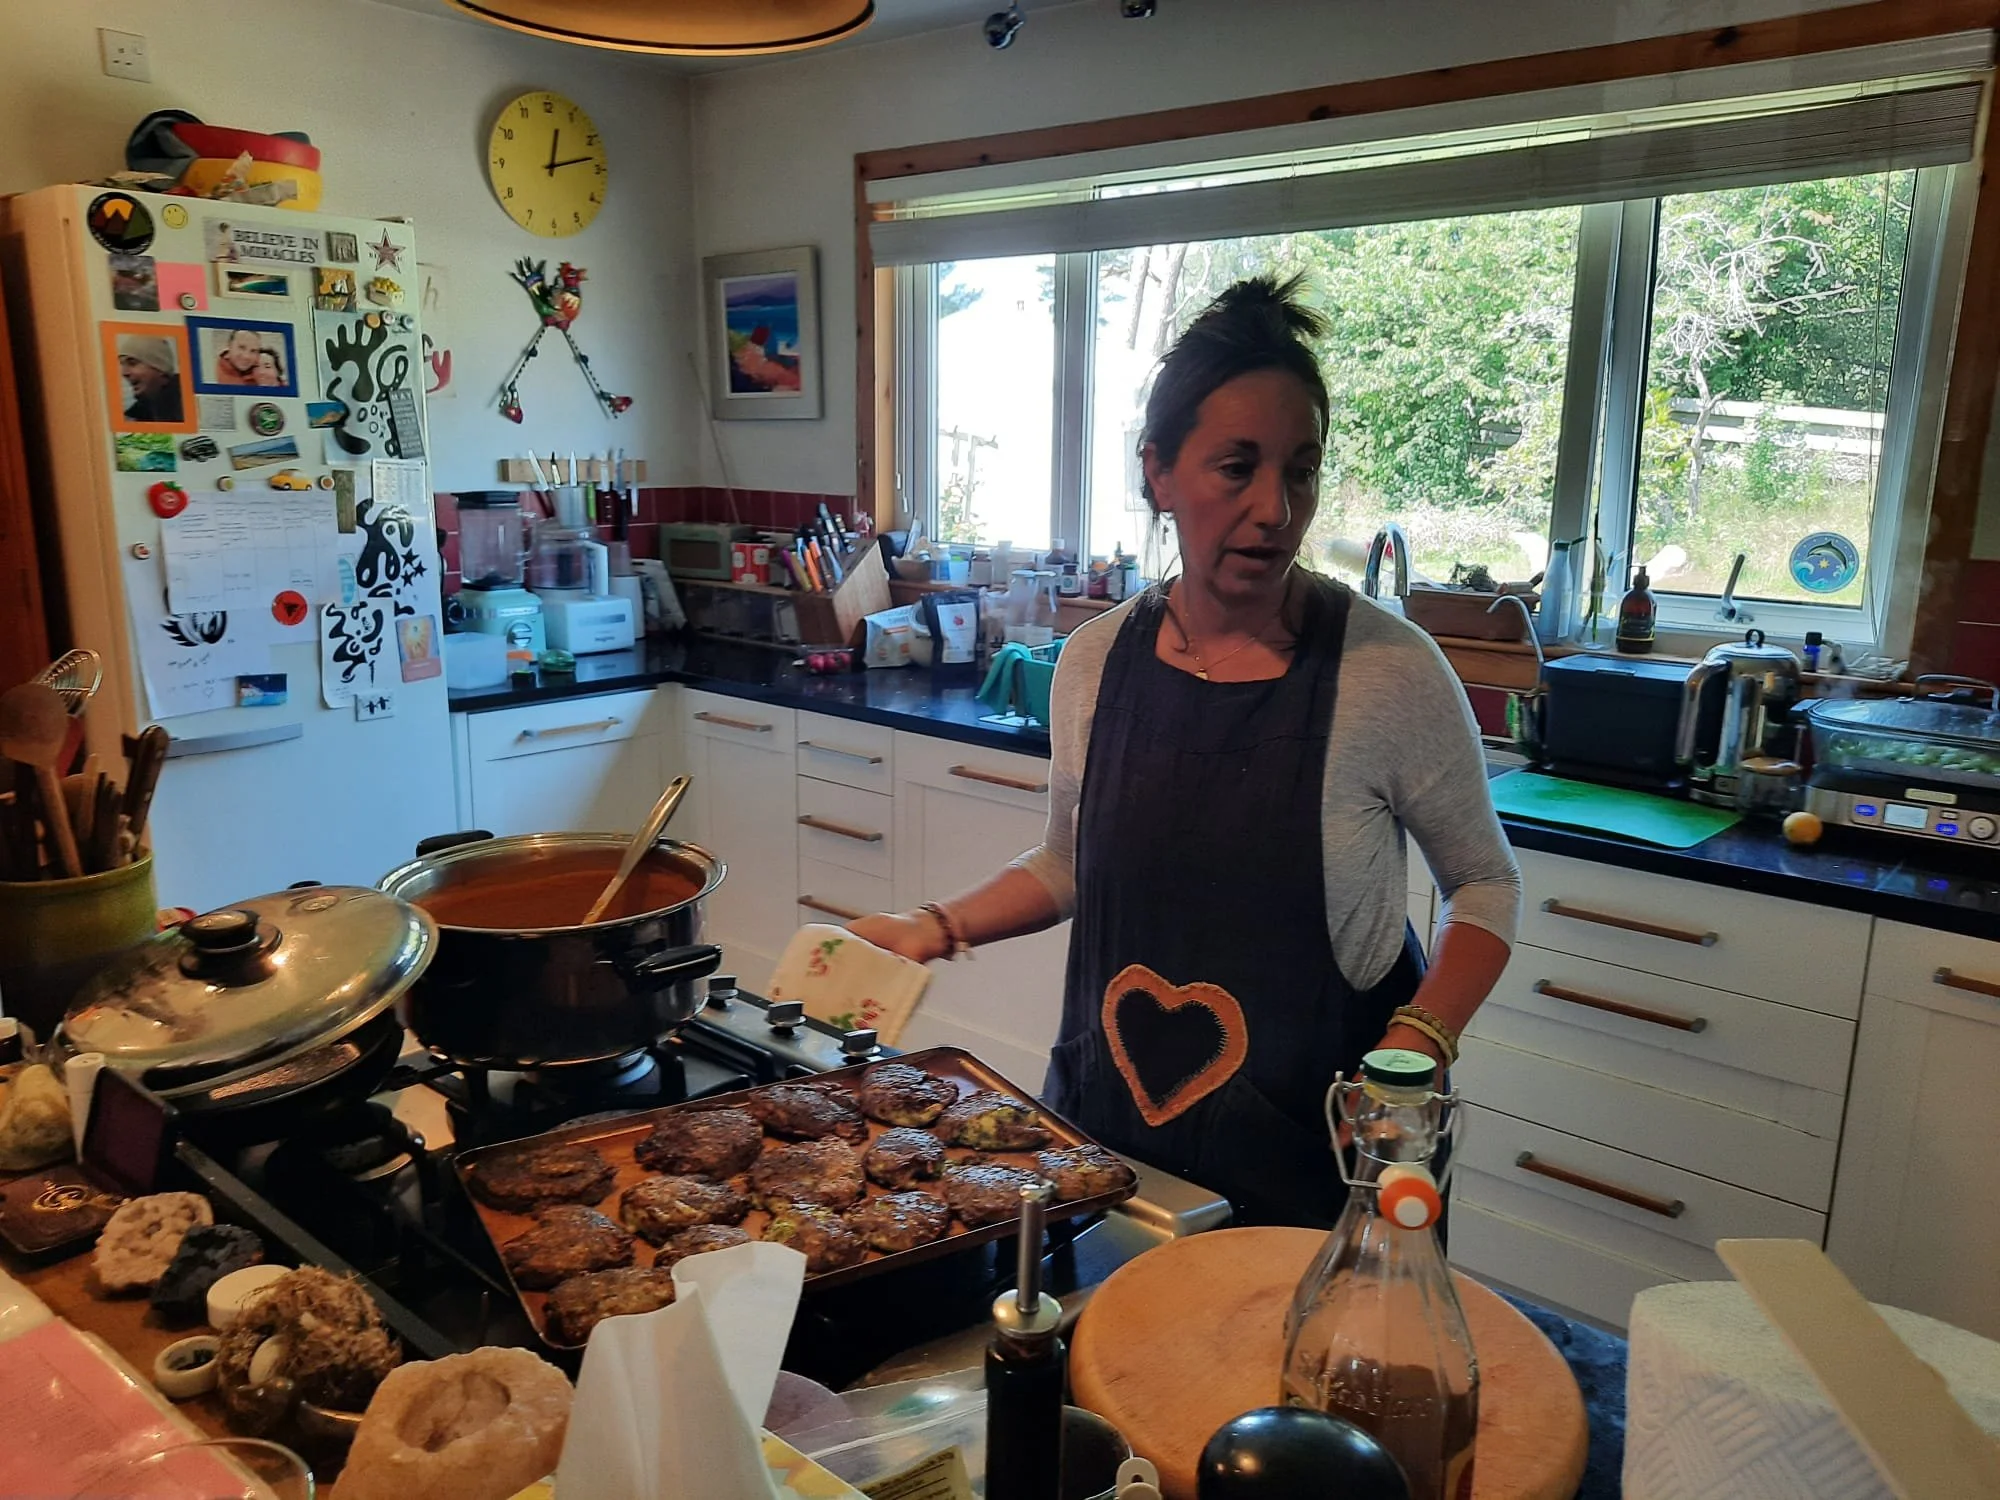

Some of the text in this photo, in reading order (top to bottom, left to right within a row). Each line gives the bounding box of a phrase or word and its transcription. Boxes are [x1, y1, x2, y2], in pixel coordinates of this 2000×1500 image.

[520, 107, 529, 119] 11
[543, 101, 553, 114] 12
[503, 129, 514, 140] 10
[499, 158, 505, 169] 9
[507, 187, 514, 199] 8
[233, 230, 297, 248] BELIEVE
[303, 237, 320, 250] IN
[240, 245, 316, 264] MIRACLES
